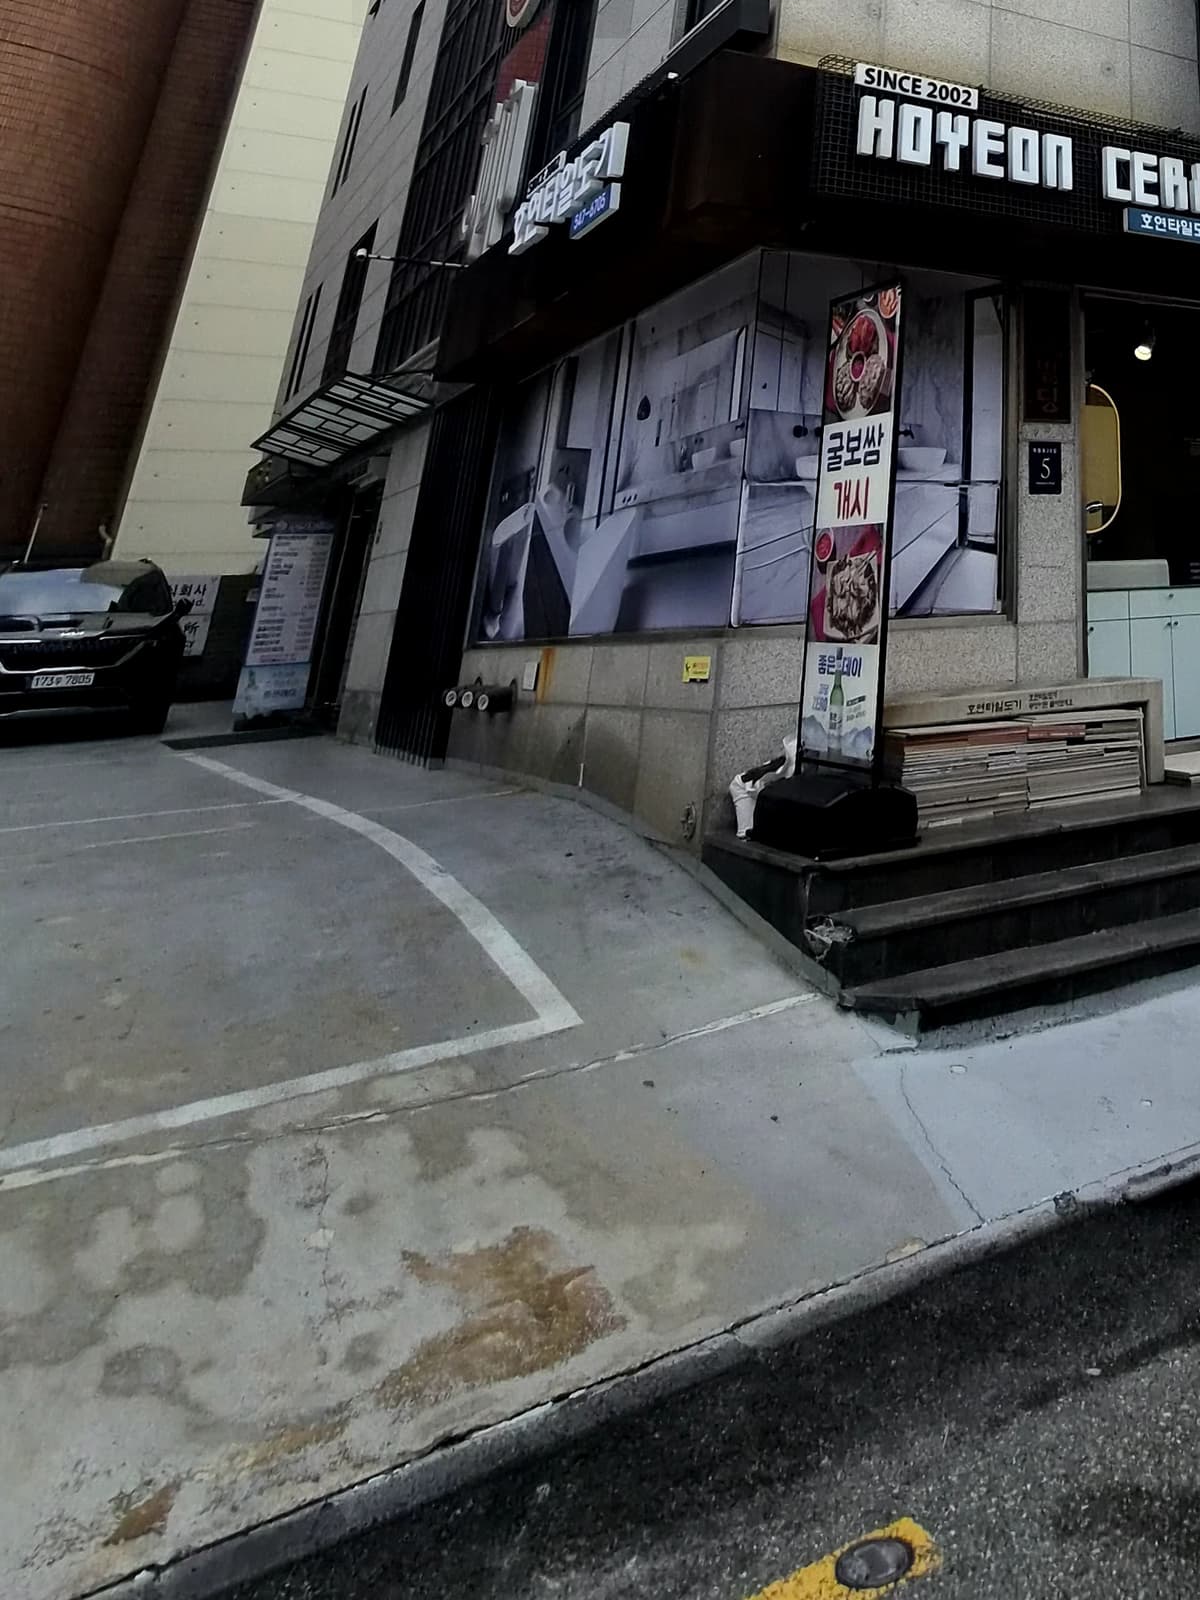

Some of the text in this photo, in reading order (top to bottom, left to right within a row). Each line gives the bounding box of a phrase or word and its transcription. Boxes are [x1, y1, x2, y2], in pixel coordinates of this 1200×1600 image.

[863, 66, 973, 106] SINCE 2002
[857, 95, 1074, 191] HOYEON
[827, 423, 885, 472] 굴보쌈
[1040, 457, 1051, 479] 5
[833, 477, 870, 520] 개시
[967, 700, 1022, 715] 호연타일도기
